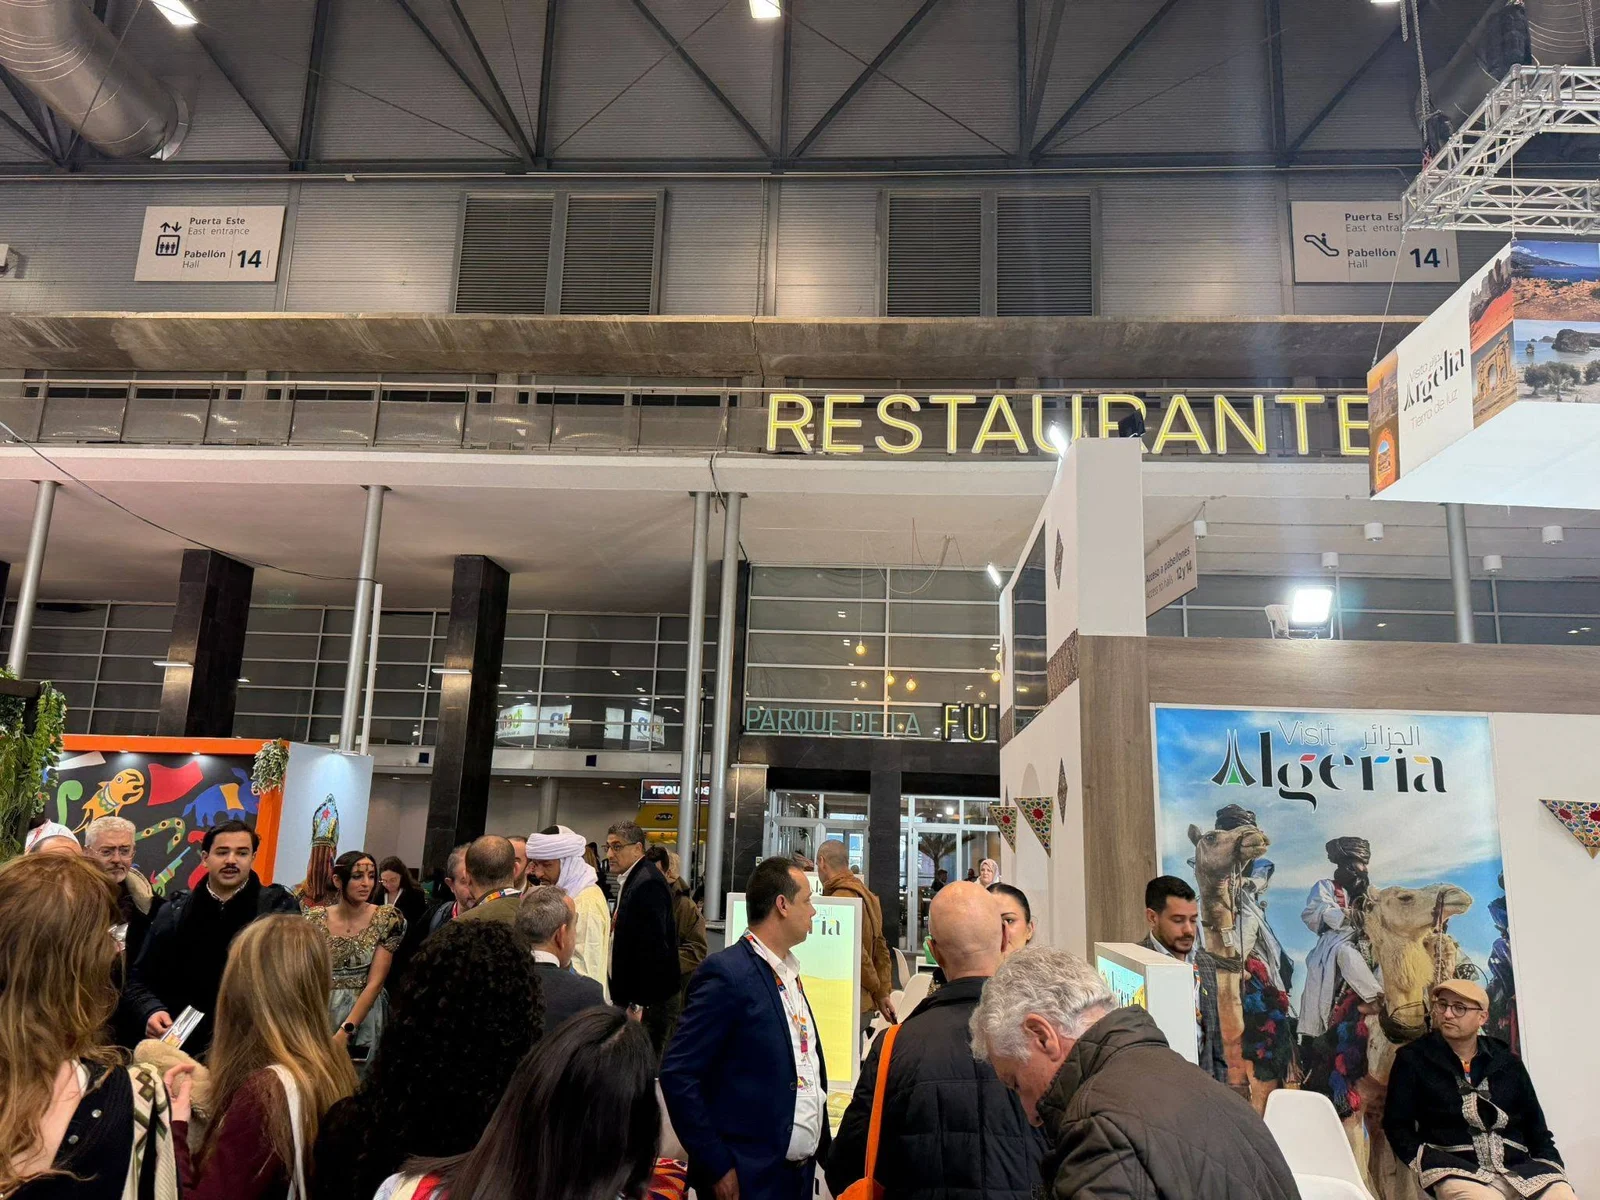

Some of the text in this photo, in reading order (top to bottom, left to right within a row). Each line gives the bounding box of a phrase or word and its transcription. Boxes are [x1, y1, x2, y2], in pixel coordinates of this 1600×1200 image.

[189, 217, 245, 225] Puerta Este
[1344, 213, 1382, 221] Puerta
[188, 227, 206, 235] East
[1345, 224, 1366, 232] East
[184, 250, 226, 258] Pabellón
[1347, 248, 1396, 257] Pabellón
[237, 250, 262, 268] 14
[1409, 248, 1441, 268] 14
[182, 260, 200, 269] Hall
[1348, 260, 1367, 268] Hall
[1403, 348, 1464, 412] Argelia
[746, 707, 841, 735] PARQUE
[851, 711, 881, 735] DE
[891, 712, 922, 737] LA
[1277, 720, 1337, 746] Visit
[1360, 723, 1421, 751] الجزائر
[1210, 728, 1448, 813] Algeria
[650, 785, 710, 796] TEQUOS
